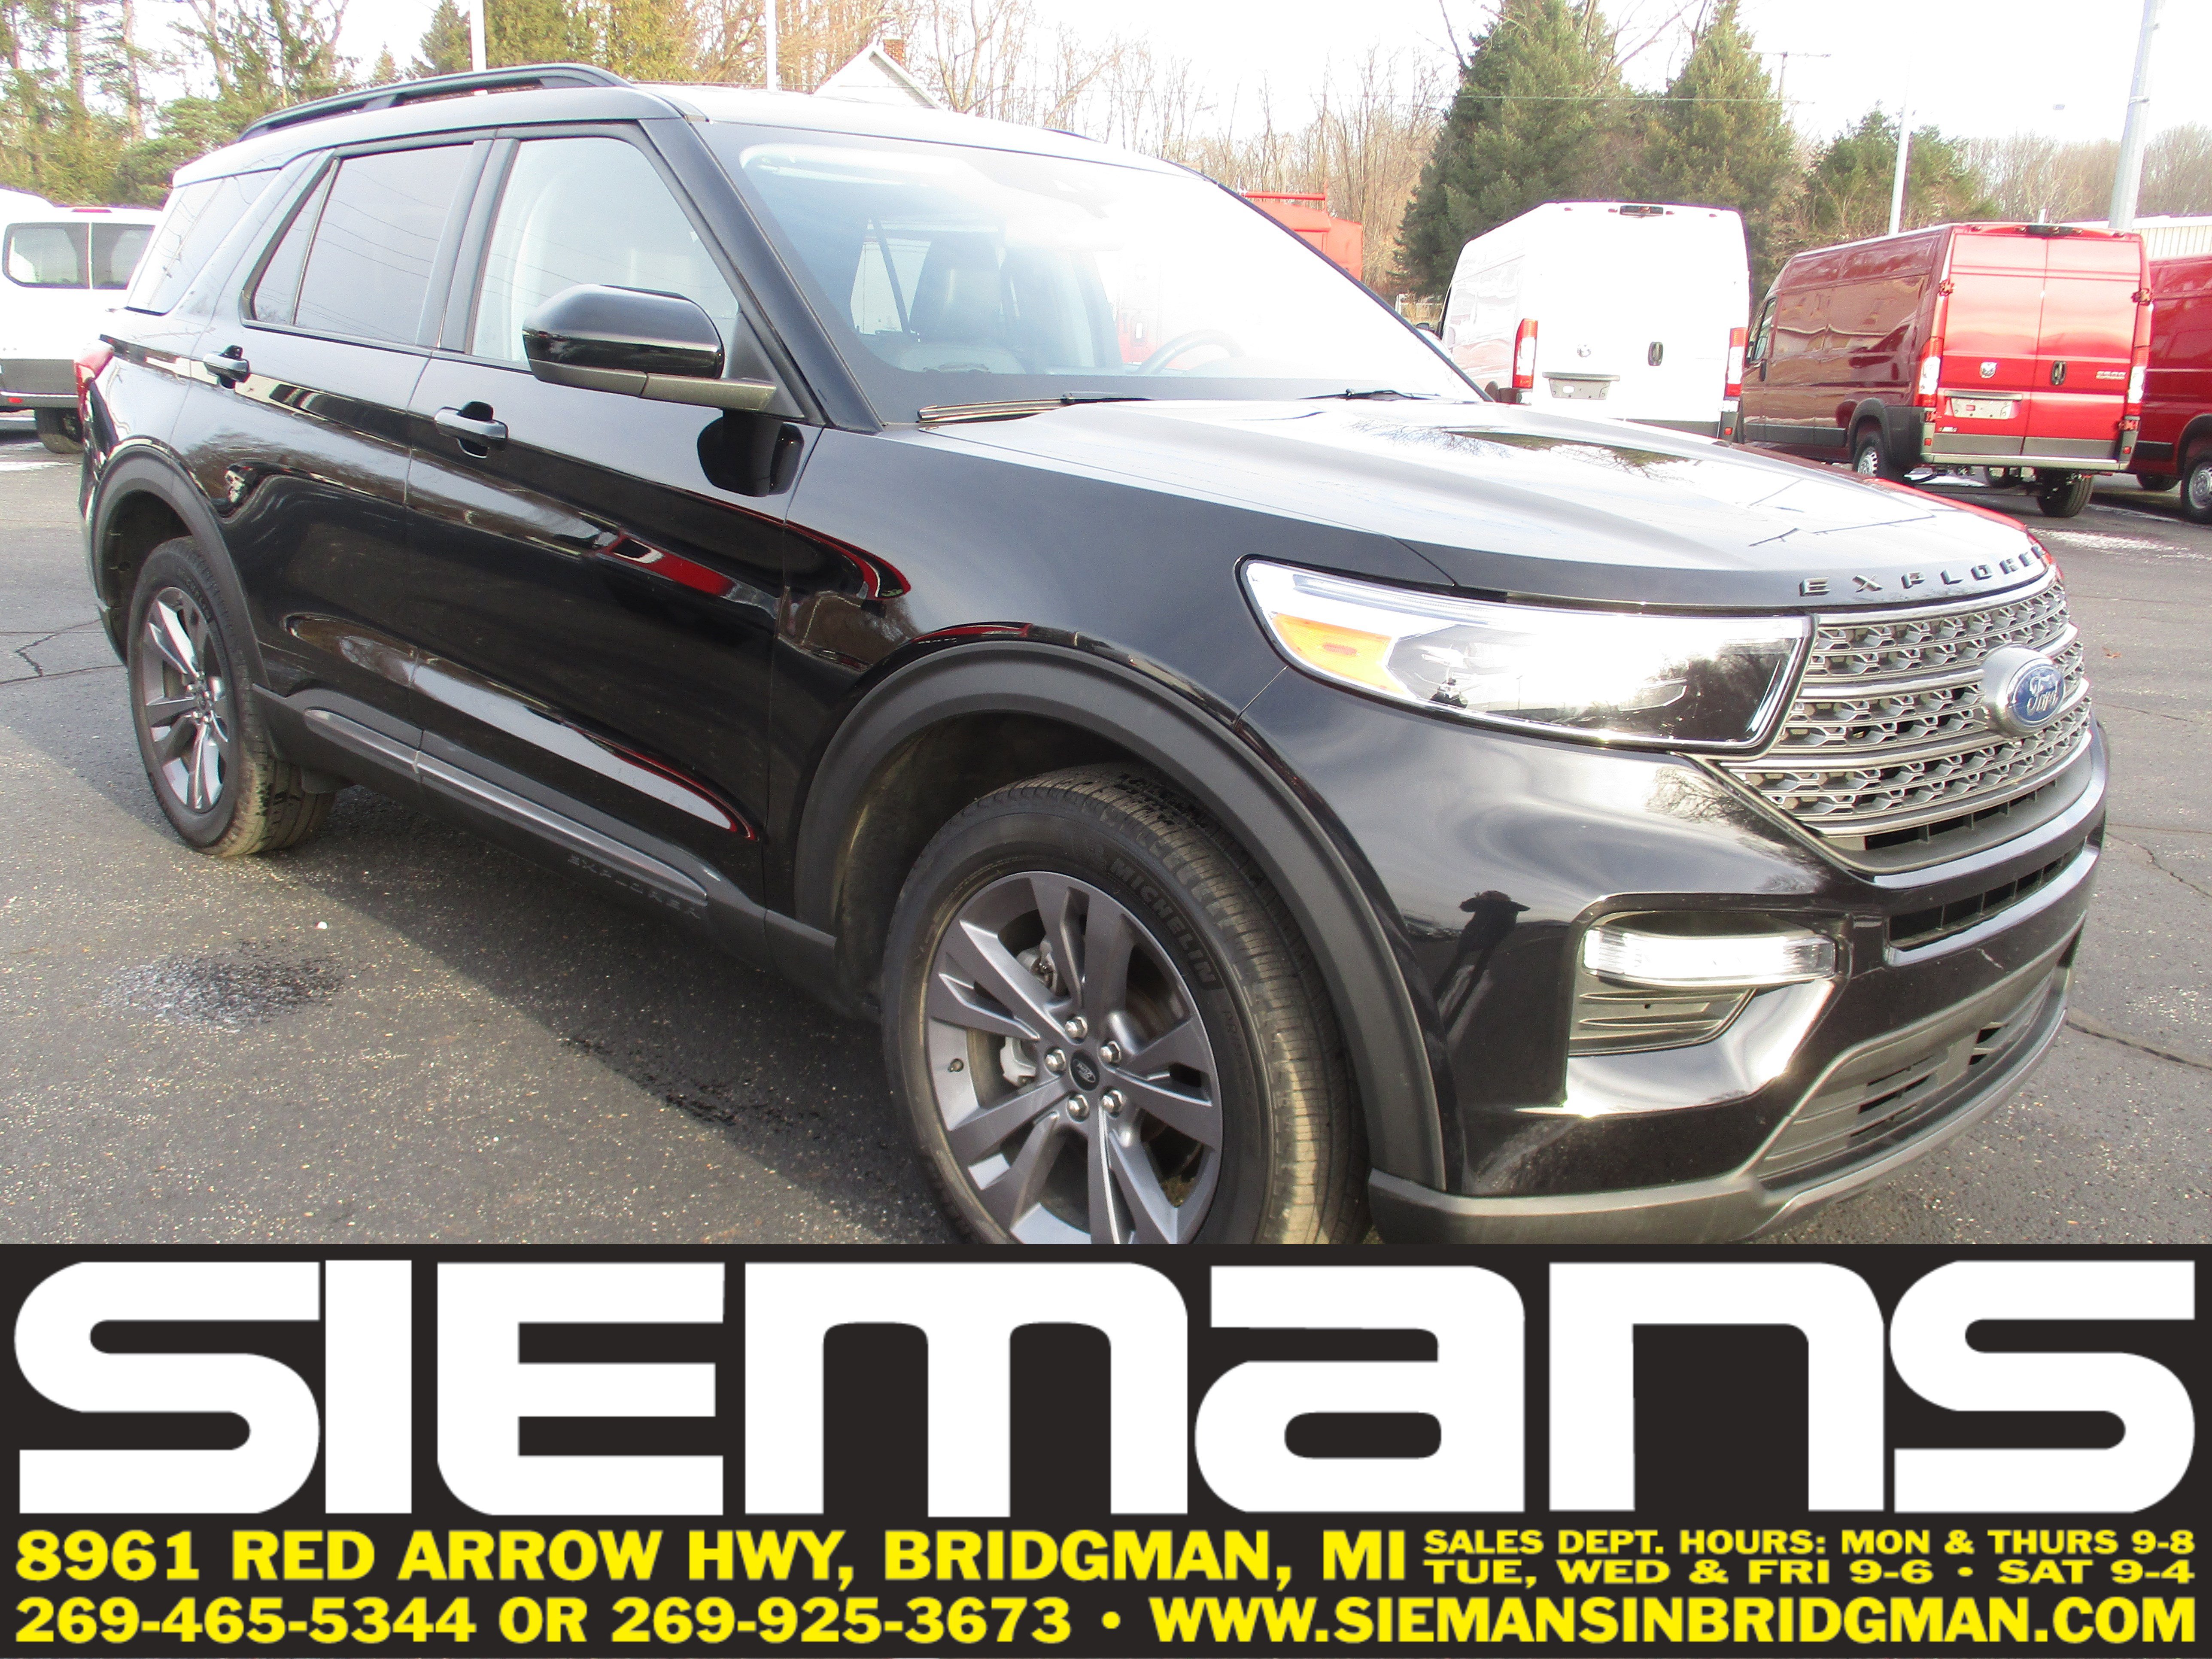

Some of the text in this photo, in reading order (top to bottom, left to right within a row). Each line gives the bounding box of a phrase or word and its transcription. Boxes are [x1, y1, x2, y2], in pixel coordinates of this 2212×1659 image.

[1799, 544, 2048, 597] EXPLORER
[2027, 674, 2060, 716] Ford
[1109, 857, 1216, 982] MICHELIN
